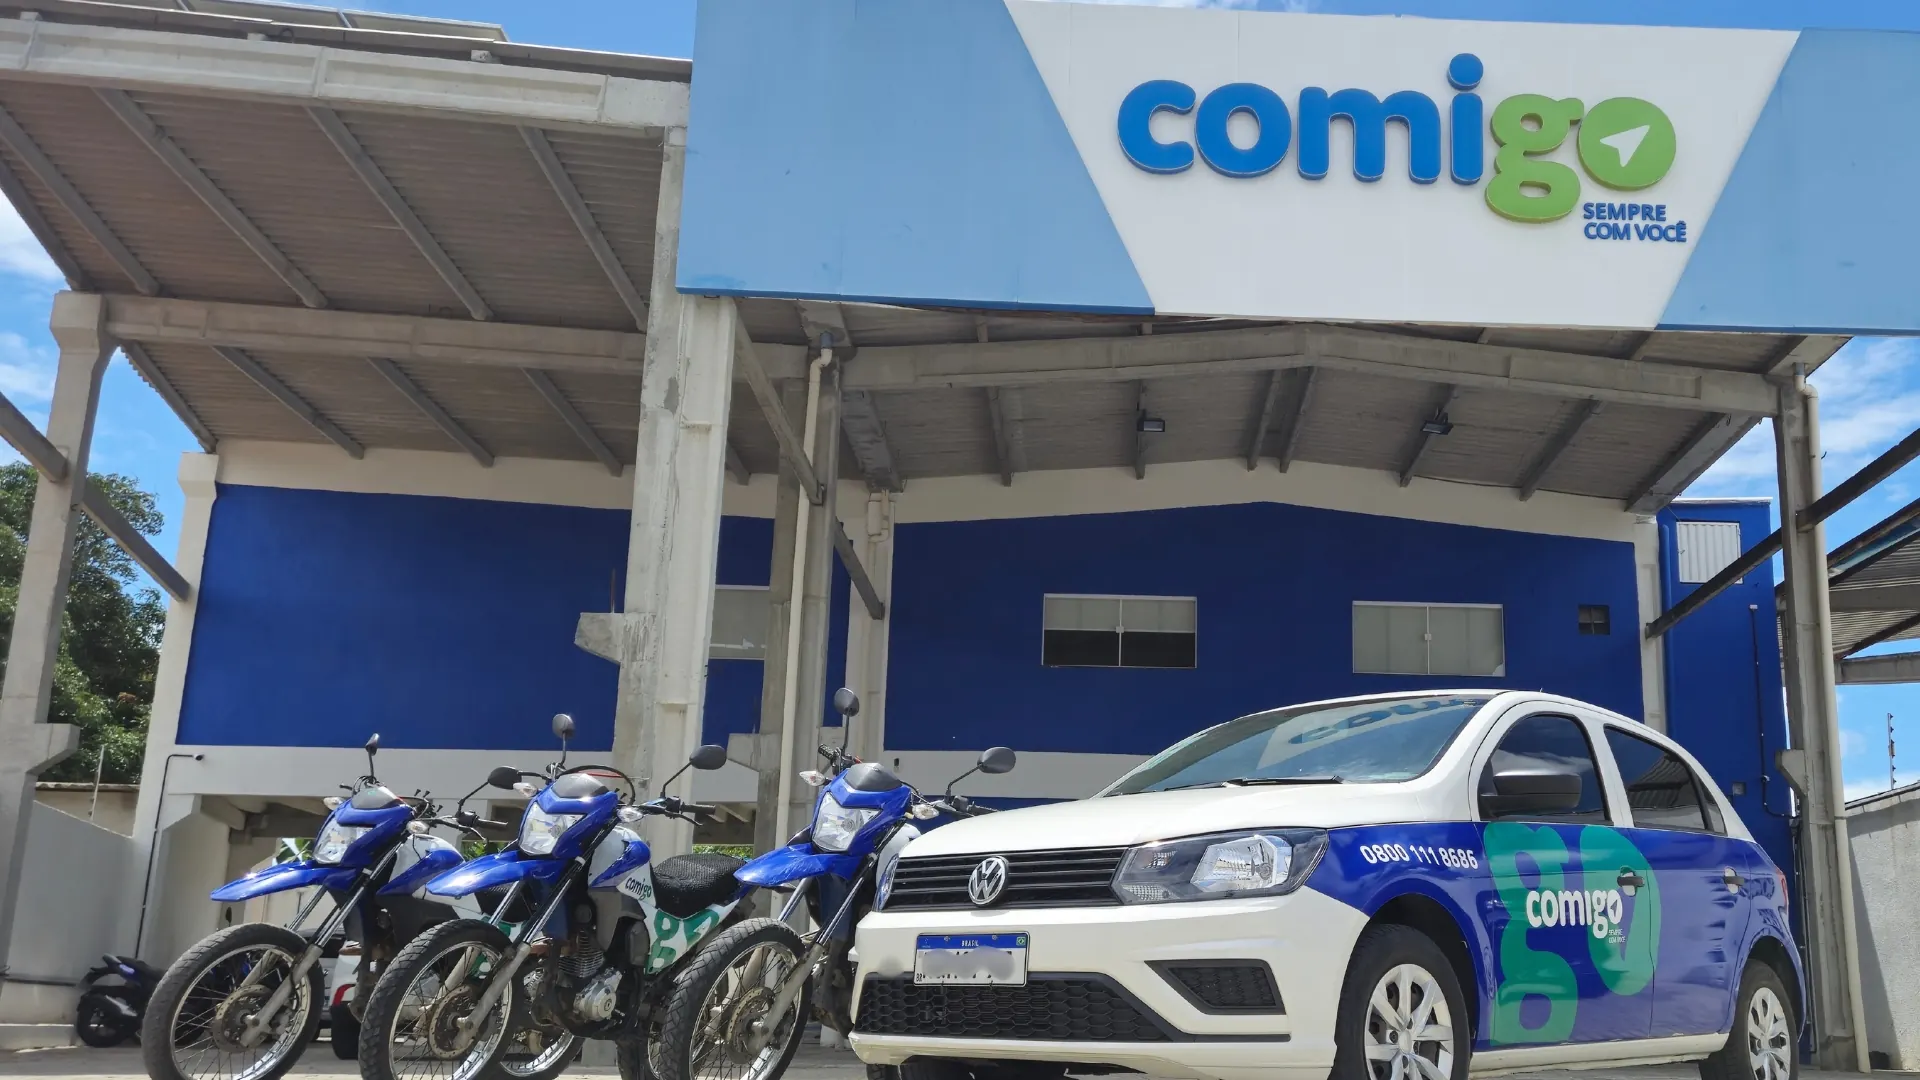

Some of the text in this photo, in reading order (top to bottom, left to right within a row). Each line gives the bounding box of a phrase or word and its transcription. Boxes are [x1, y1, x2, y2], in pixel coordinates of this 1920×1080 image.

[1117, 53, 1677, 223] comigo
[1583, 203, 1666, 221] SEMPRE
[1584, 220, 1687, 242] COM VOCÊ
[1360, 844, 1479, 869] 0800 111 8686
[625, 876, 653, 900] comigo
[1526, 889, 1623, 939] comigo
